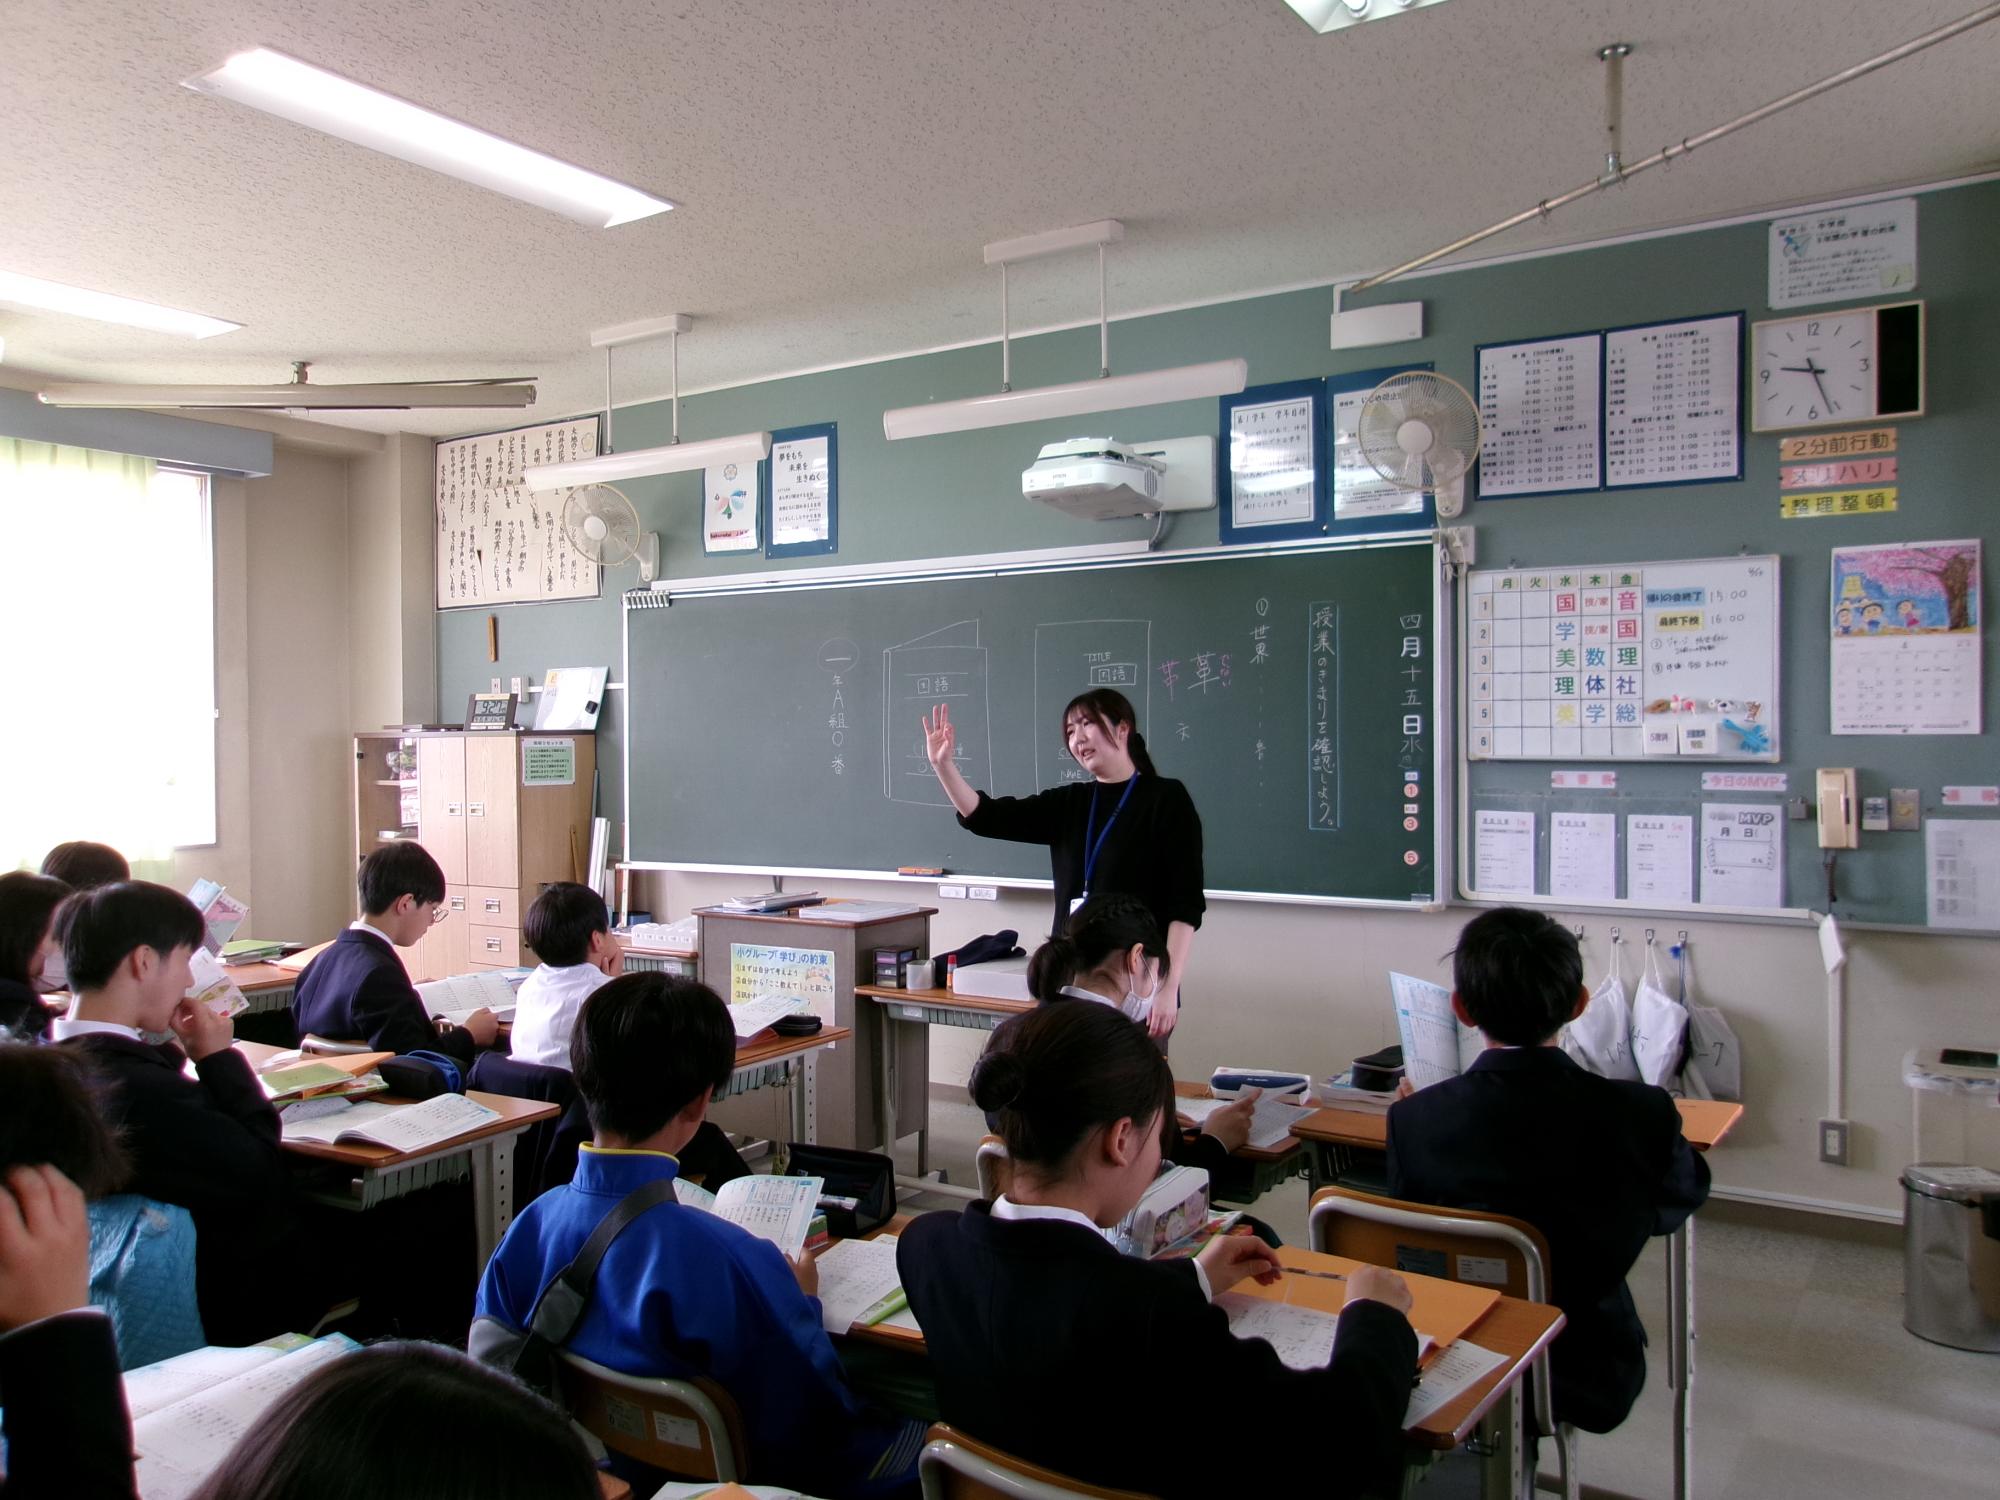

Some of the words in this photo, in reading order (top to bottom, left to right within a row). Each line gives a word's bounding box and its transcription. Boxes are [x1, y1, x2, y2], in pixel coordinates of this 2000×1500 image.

[1807, 323, 1820, 336] 12
[1860, 358, 1869, 371] 3
[1760, 370, 1770, 384] 9
[1808, 406, 1818, 419] 6
[1793, 432, 1889, 456] 2分前行動
[779, 451, 803, 464] 夢をもち
[1792, 462, 1882, 485] メリハリ
[1791, 493, 1885, 515] 整理整頓
[1502, 578, 1512, 589] 月
[1530, 577, 1541, 588] 火
[1560, 575, 1571, 586] 水
[1589, 575, 1601, 586] 木
[1620, 574, 1632, 585] 金
[1483, 601, 1487, 610] 1
[1557, 593, 1575, 612] 国
[1617, 591, 1637, 611] 音
[1659, 616, 1700, 626] 最終下校
[1480, 629, 1486, 639] 2
[1555, 622, 1575, 641] 学
[1617, 619, 1637, 638] 国
[1250, 625, 1271, 664] 世界
[1084, 652, 1111, 662] TITLE
[1481, 655, 1487, 665] 3
[1555, 648, 1575, 668] 美
[1585, 647, 1605, 667] 数
[1617, 647, 1638, 666] 理
[1098, 666, 1127, 683] 国語
[917, 676, 949, 694] 国語
[1481, 682, 1487, 691] 4
[1555, 676, 1575, 695] 理
[1585, 675, 1605, 694] 体
[1616, 675, 1636, 695] 社
[1312, 606, 1336, 826] 授業のきまりを確認しよう。
[1481, 709, 1487, 719] 5
[1586, 704, 1606, 723] 学
[1615, 703, 1636, 722] 総
[1481, 737, 1487, 746] 6
[1060, 769, 1081, 783] NAME
[1709, 775, 1770, 787] 今日のMVP
[1738, 812, 1774, 826] MVP
[1720, 827, 1730, 837] 月
[737, 947, 828, 965] 小グループ「学び」の約束
